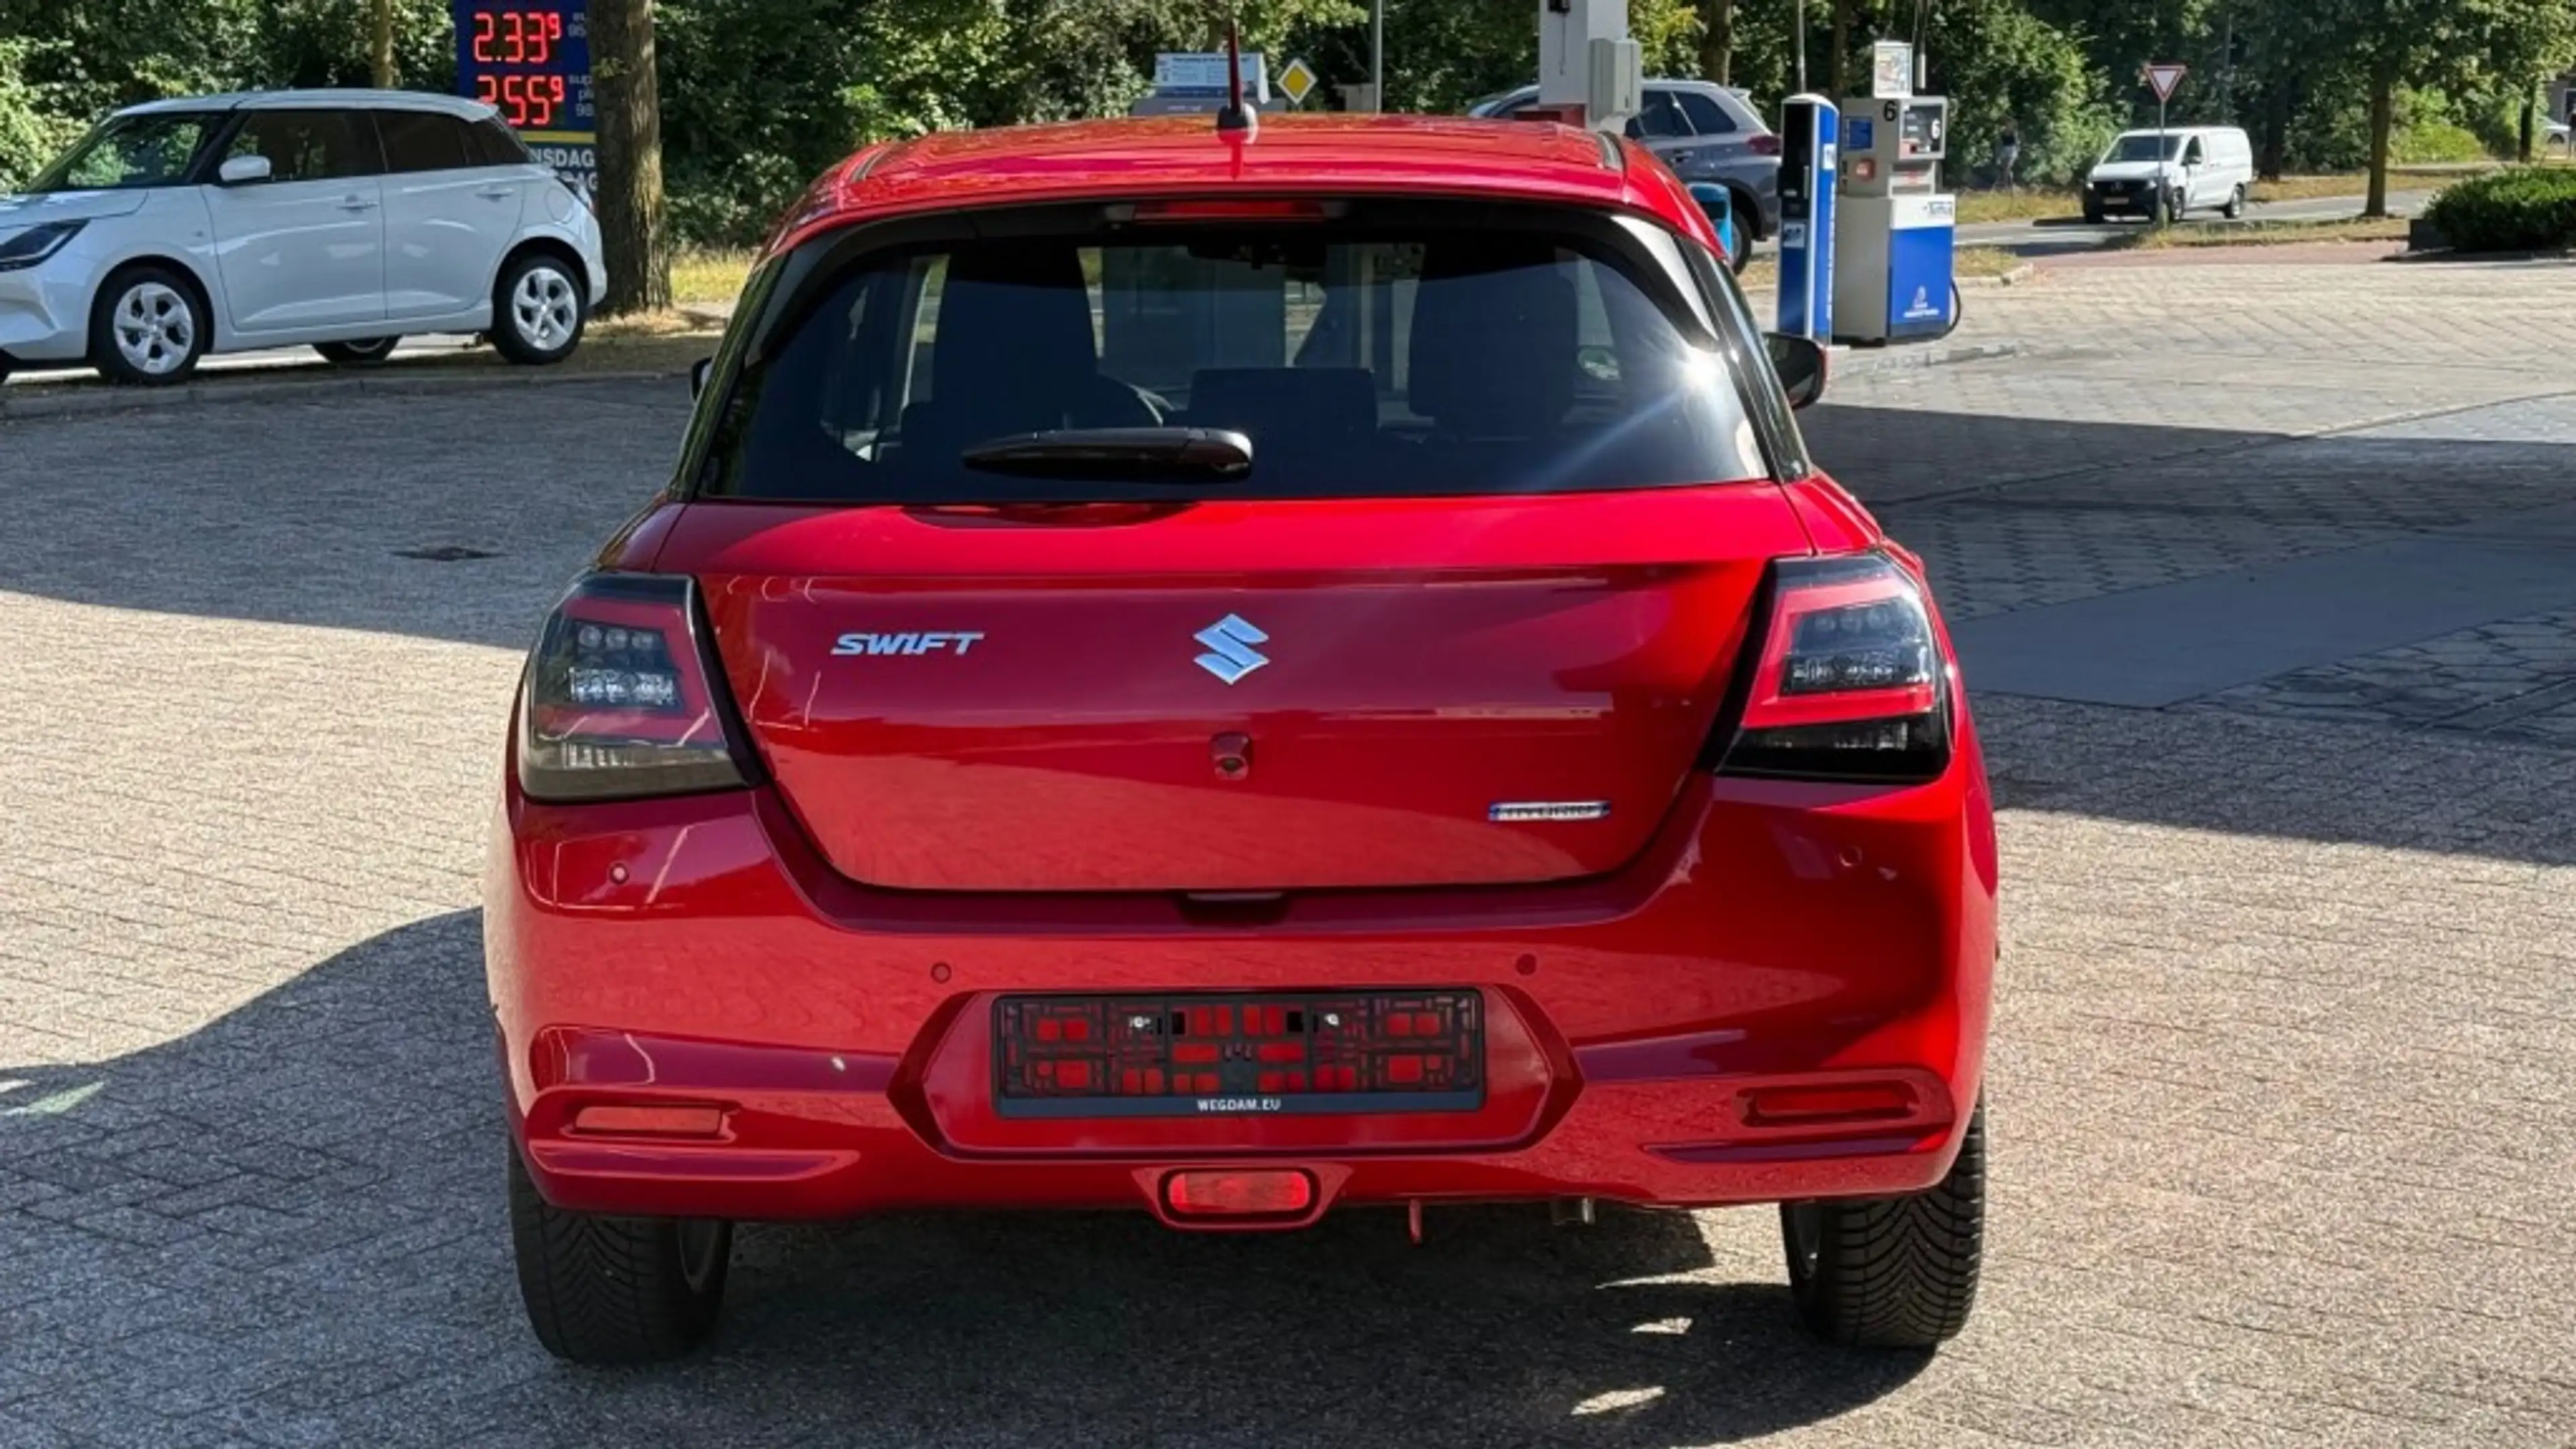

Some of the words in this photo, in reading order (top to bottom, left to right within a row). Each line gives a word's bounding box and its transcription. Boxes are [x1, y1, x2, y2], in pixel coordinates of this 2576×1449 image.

[1883, 100, 1896, 122] 6
[1931, 118, 1941, 140] 6
[830, 633, 985, 655] SWIFT
[1197, 1097, 1282, 1112] WEGDAM.EU
